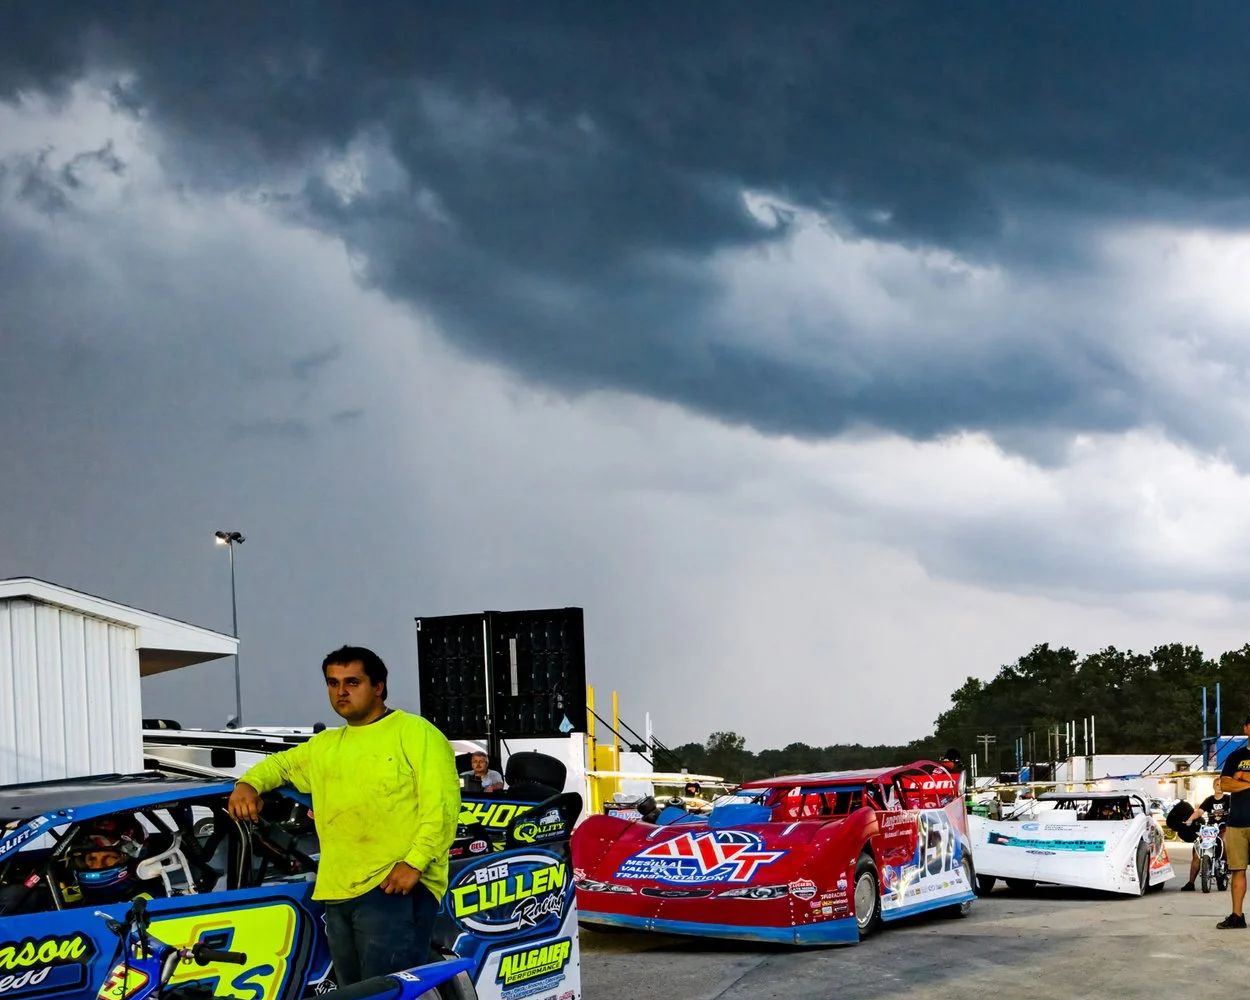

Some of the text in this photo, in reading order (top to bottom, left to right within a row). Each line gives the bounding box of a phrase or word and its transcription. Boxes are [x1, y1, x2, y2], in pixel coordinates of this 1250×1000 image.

[513, 823, 565, 843] QUALITY
[471, 842, 485, 851] BELL
[474, 863, 509, 884] BOB
[621, 865, 666, 874] VALLEY
[625, 859, 678, 868] MESILLA
[615, 871, 727, 882] TRANSPORTATION
[450, 863, 566, 918] CULLEN
[511, 892, 565, 930] Racing
[498, 941, 571, 978] ALLGAIER
[506, 962, 560, 983] PERFORMANCE
